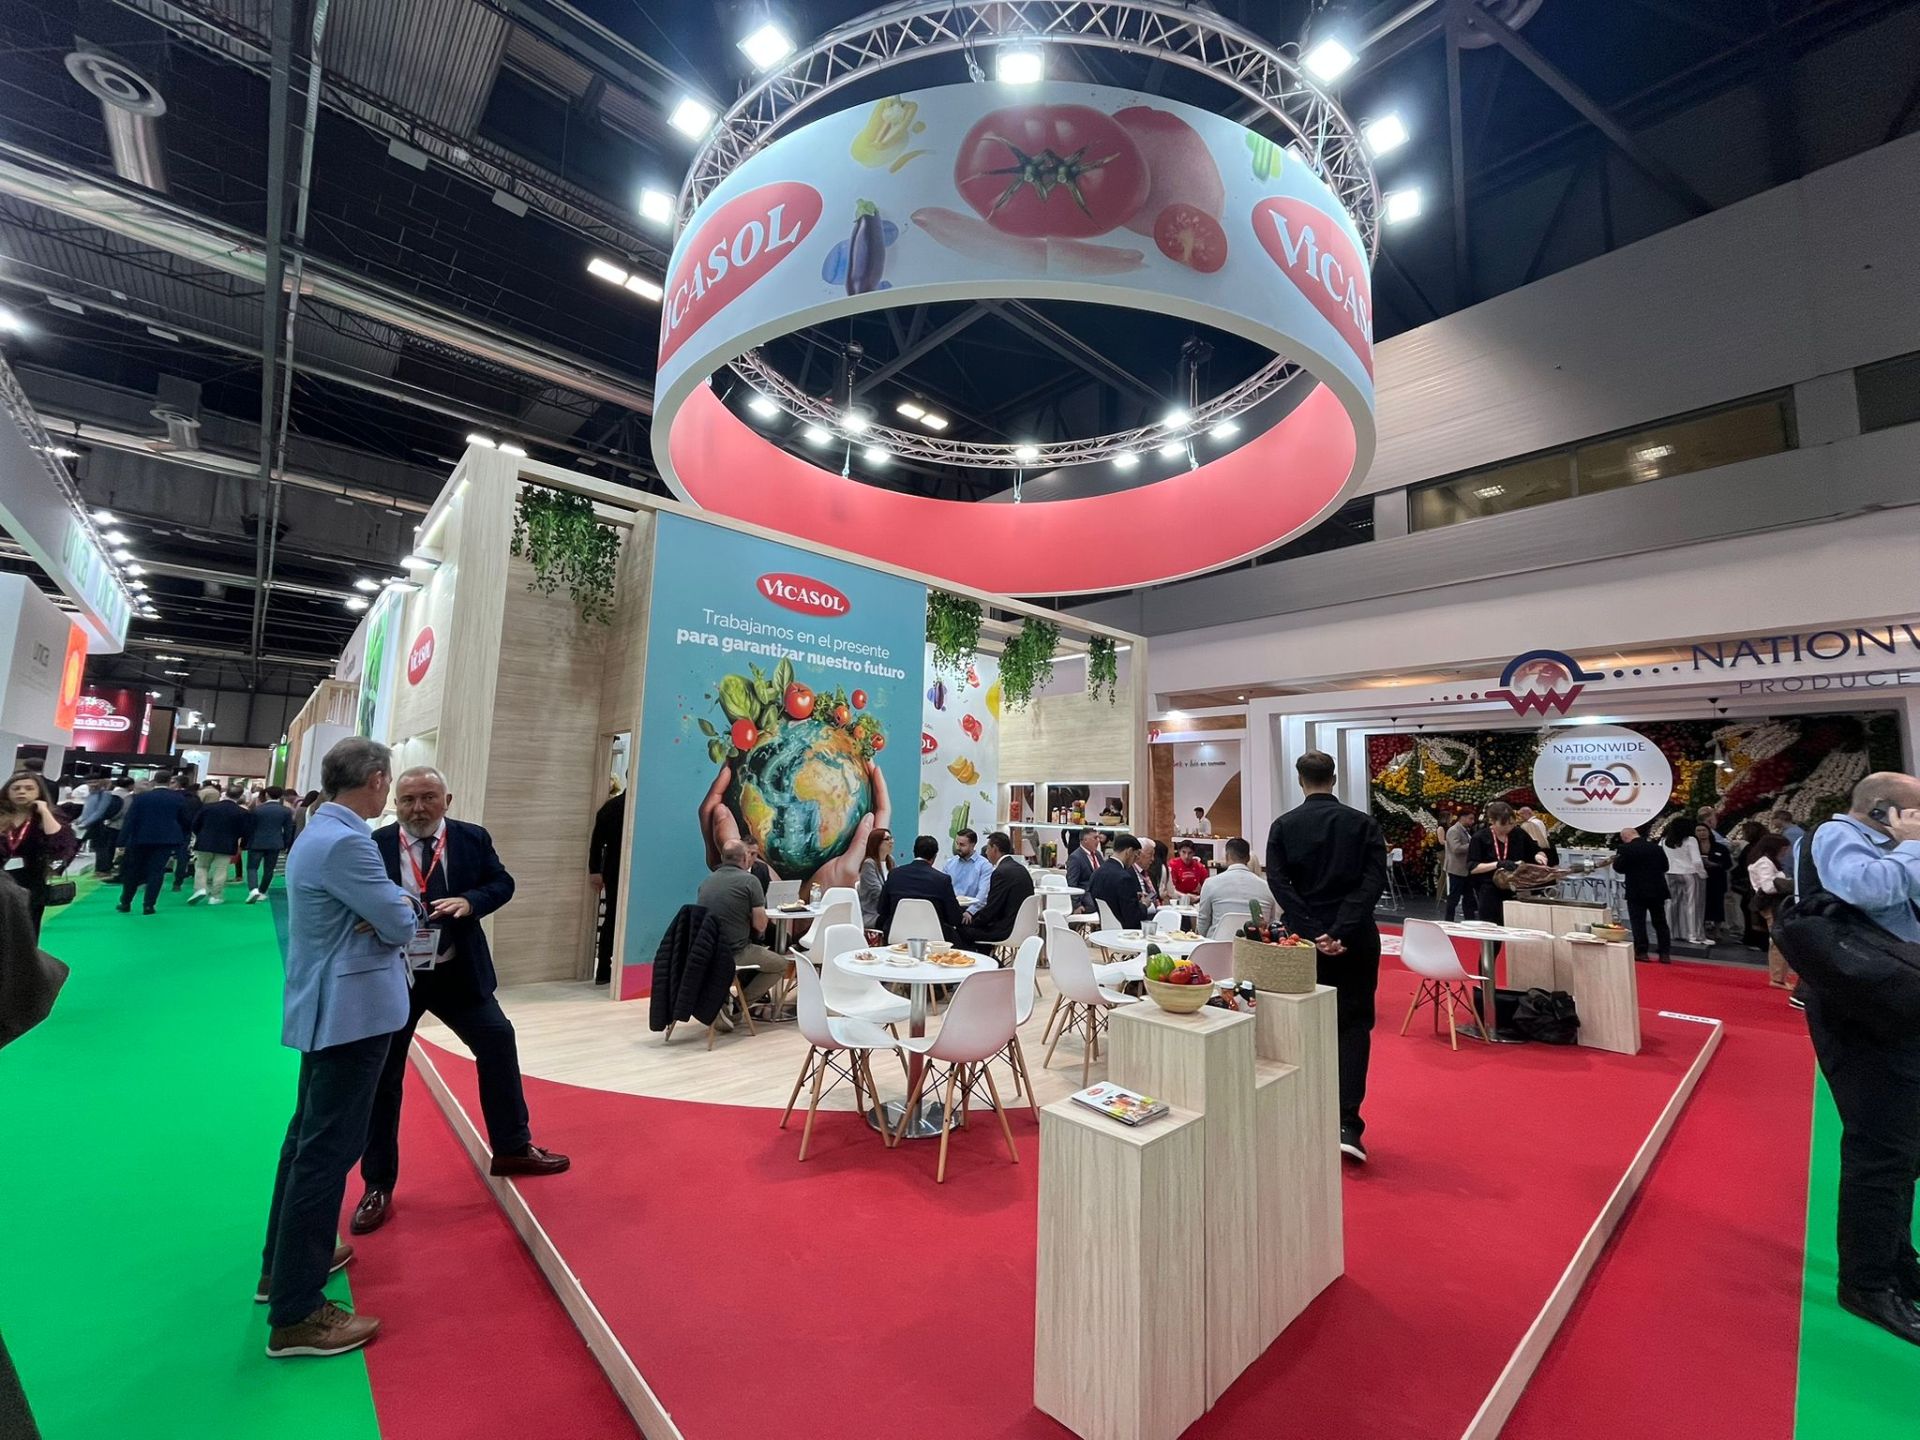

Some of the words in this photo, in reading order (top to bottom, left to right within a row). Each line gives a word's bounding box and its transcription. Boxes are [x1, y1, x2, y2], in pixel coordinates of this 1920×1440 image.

[663, 203, 802, 344] ICASOL
[1268, 208, 1373, 342] VICAS
[676, 628, 719, 647] para
[722, 635, 805, 662] garantizar
[807, 652, 862, 673] nuestro
[864, 660, 905, 680] futuro
[702, 608, 794, 641] Trabajamos
[797, 631, 815, 645] en
[818, 634, 831, 648] el
[833, 638, 890, 659] presente
[1738, 669, 1911, 696] PRODUCE
[1553, 742, 1647, 754] NATIONWIDE
